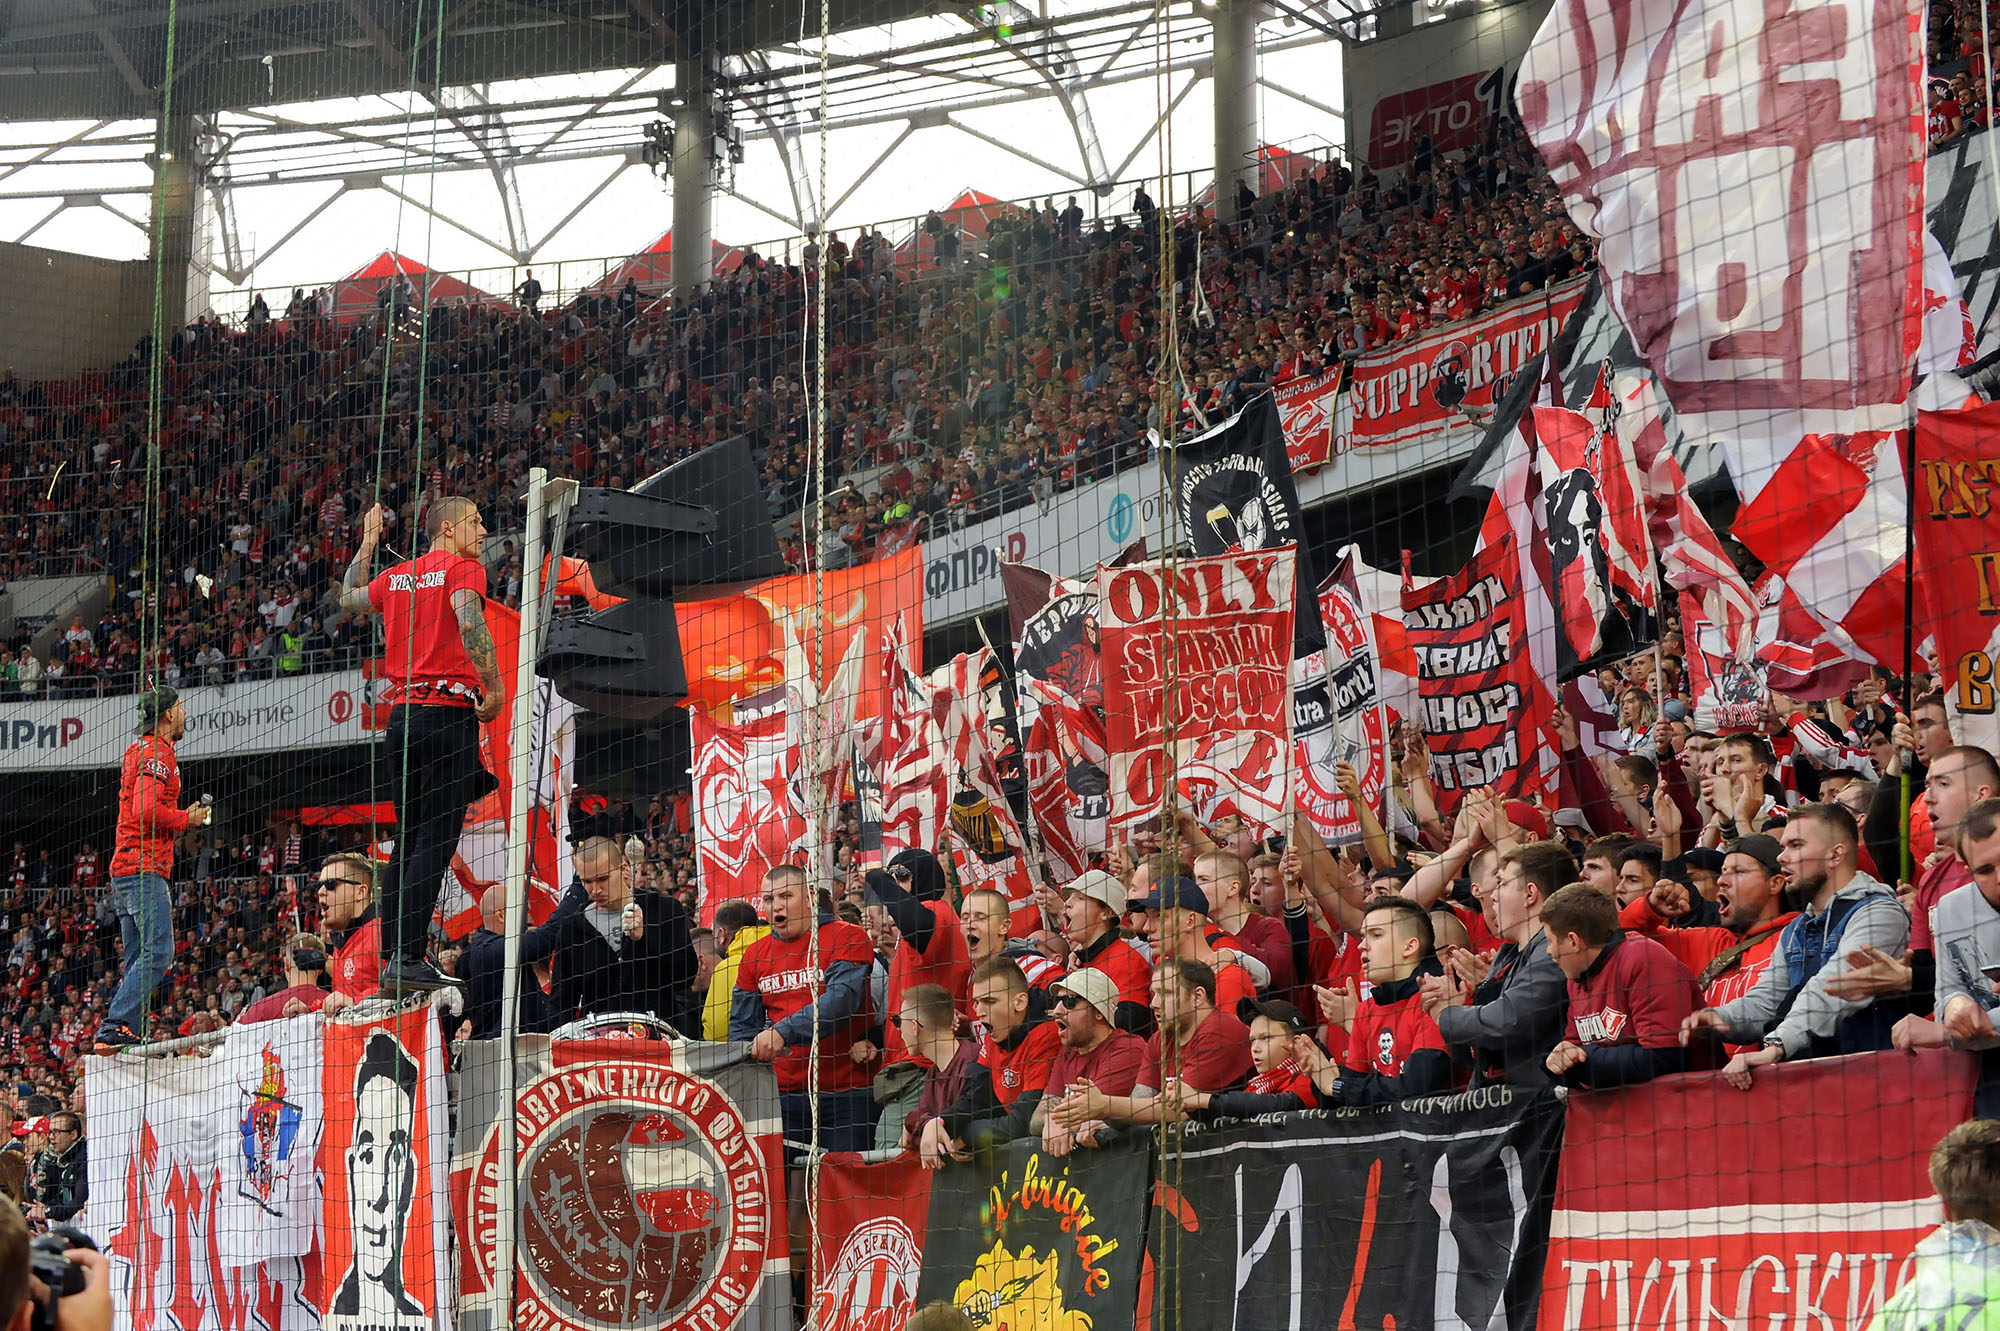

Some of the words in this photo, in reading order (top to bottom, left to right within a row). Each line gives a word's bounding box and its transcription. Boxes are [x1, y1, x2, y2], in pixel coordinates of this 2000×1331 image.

[1383, 101, 1472, 148] ЭКТО
[1109, 556, 1277, 623] ONLY
[1121, 623, 1285, 683] SPARTAK
[183, 702, 295, 735] открытие
[516, 1067, 712, 1153] ОВРЕМЕННОГО
[707, 1111, 764, 1253] ФУТБОЛА
[1562, 1251, 1916, 1331] ТУЛЬСКИ
